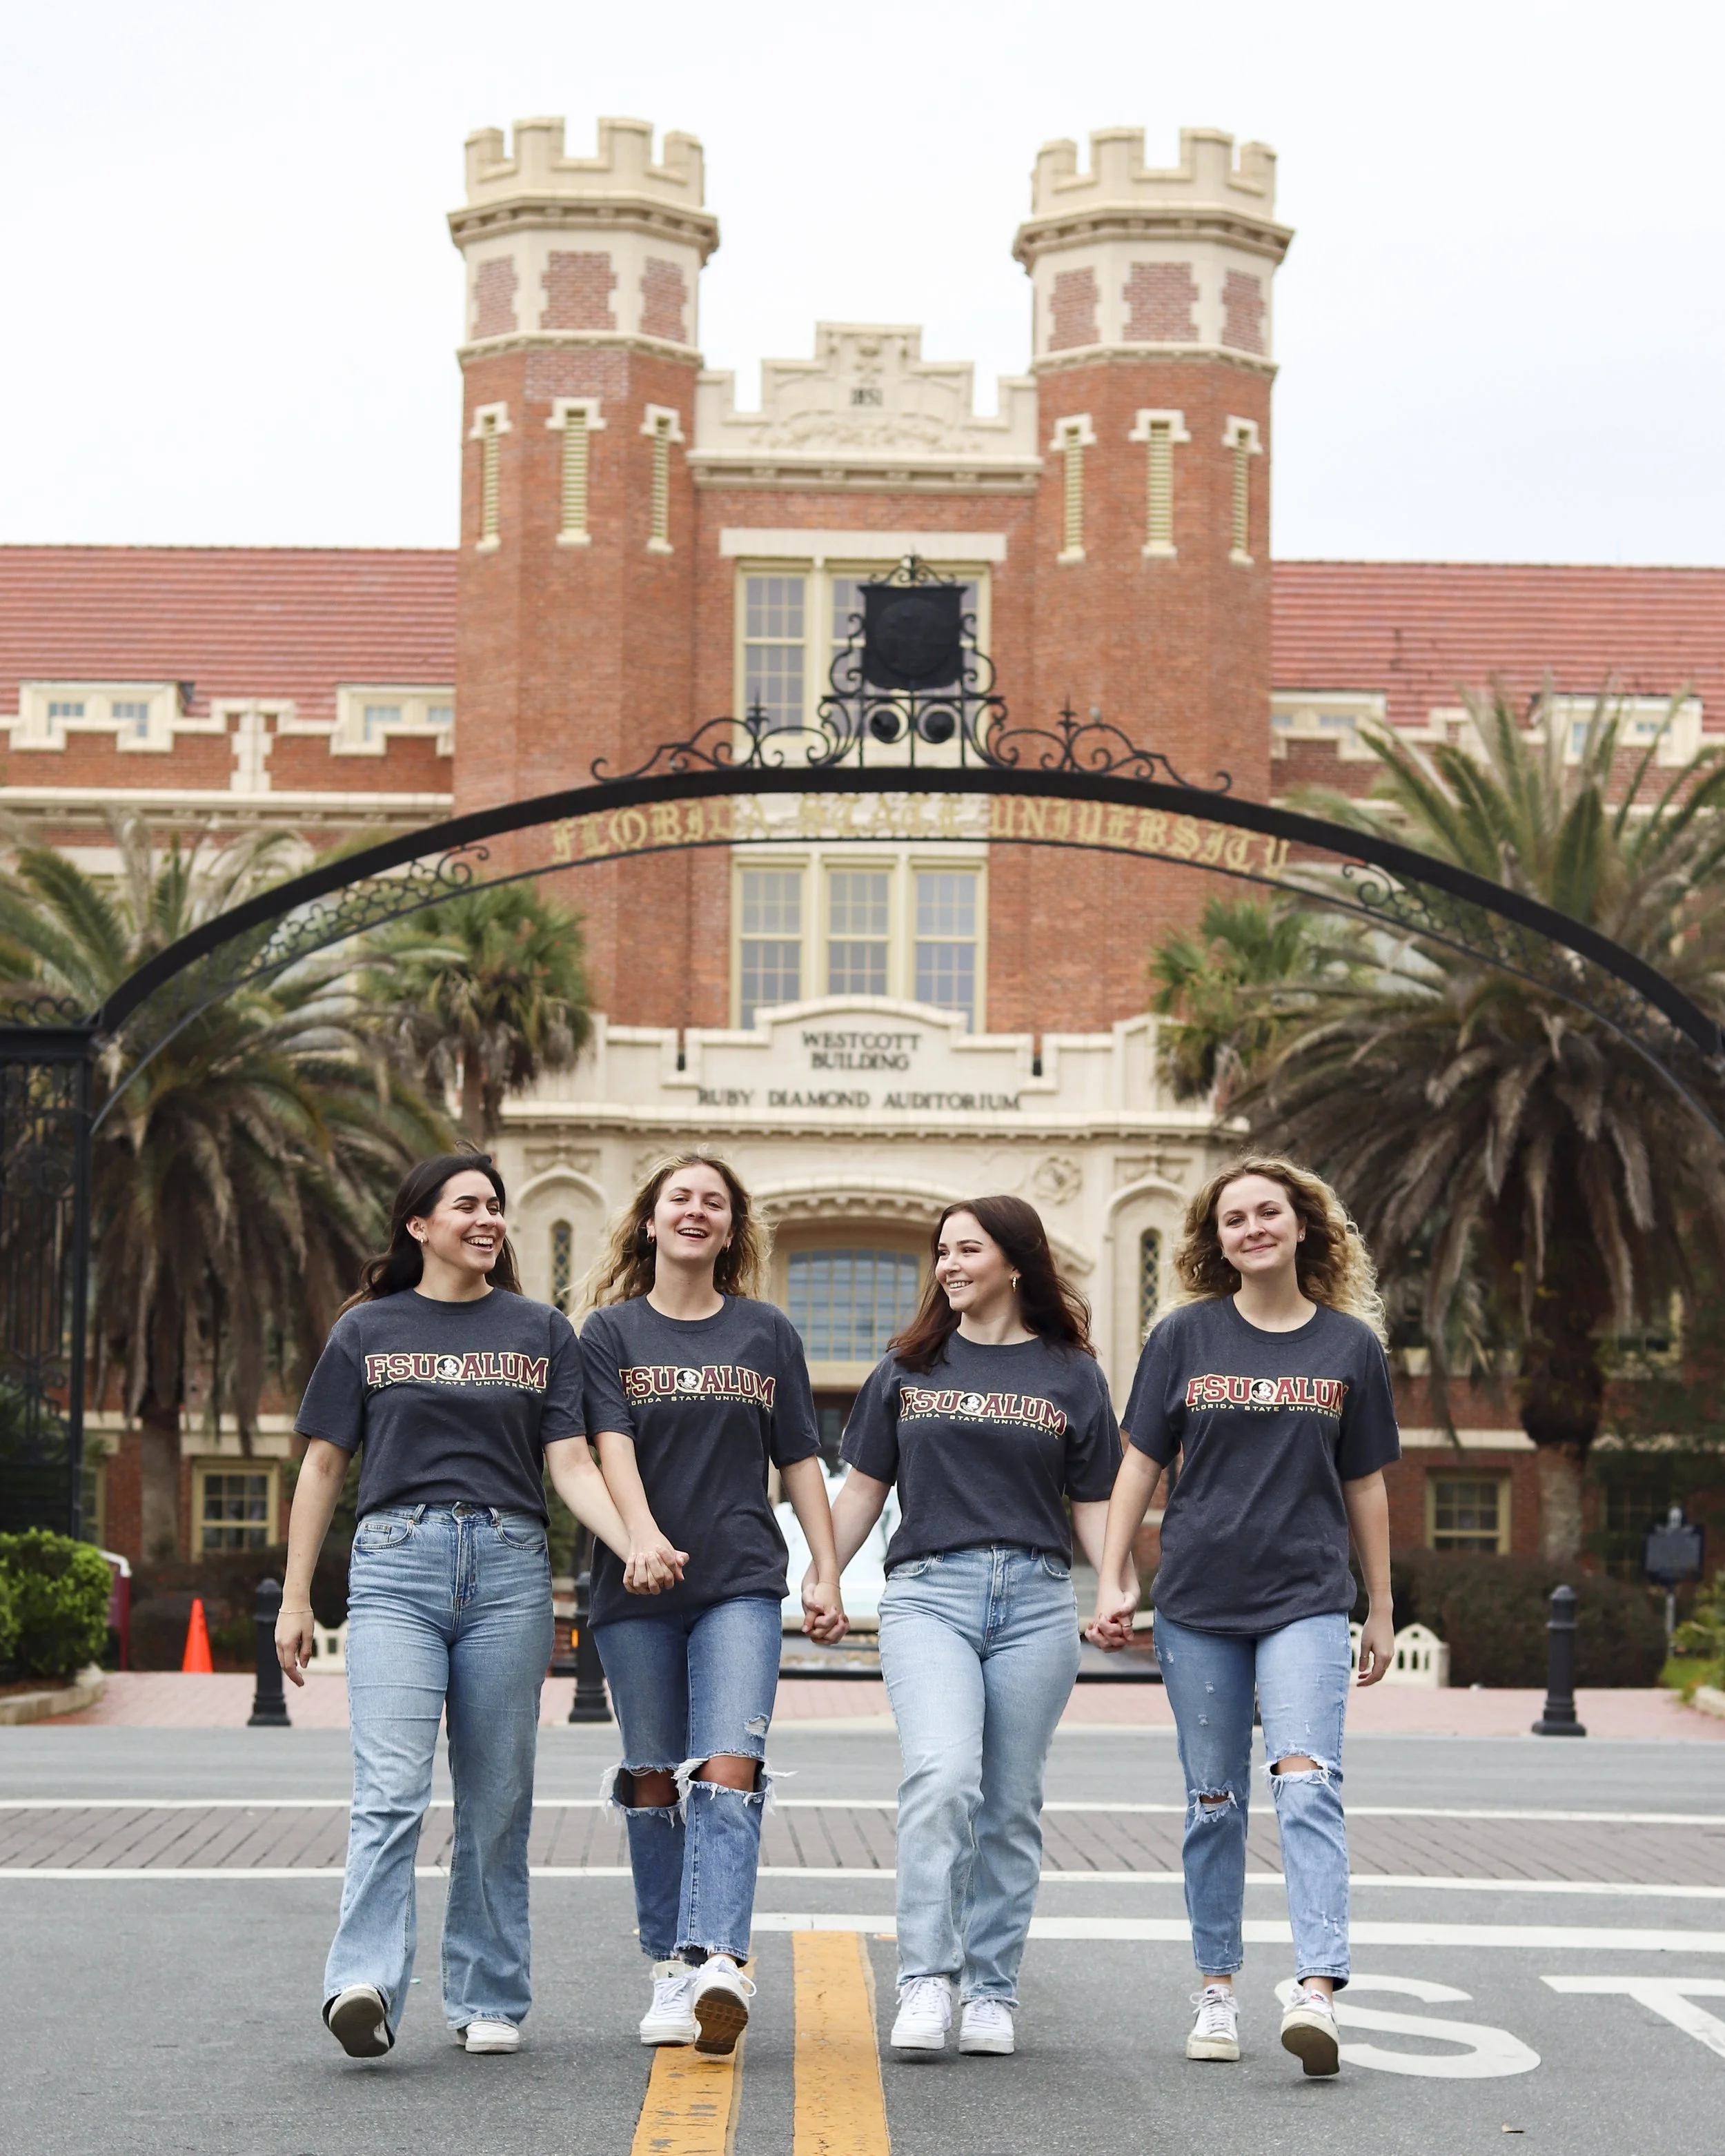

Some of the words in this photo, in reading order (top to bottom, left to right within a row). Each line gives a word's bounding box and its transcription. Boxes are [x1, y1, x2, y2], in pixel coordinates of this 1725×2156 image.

[551, 793, 771, 864] FLORIDA
[801, 1030, 921, 1050] WESTCOTT
[810, 1052, 911, 1071] BUILDING
[697, 1089, 754, 1107] RUBY
[767, 1089, 871, 1108] DIAMOND
[885, 1091, 1022, 1111] AUDITORIUM
[364, 1352, 439, 1385] FSU
[458, 1352, 549, 1389] ALUM
[475, 1381, 542, 1394] UNIVERSITY
[618, 1365, 678, 1401] FSU
[698, 1365, 776, 1408] ALUM
[1185, 1373, 1254, 1408] FSU
[631, 1396, 662, 1406] ORIDA
[899, 1386, 965, 1418] FSU
[980, 1392, 1068, 1436] ALUM
[1191, 1403, 1235, 1412] FLORIDA
[1288, 1406, 1340, 1421] UNIVERSIT
[901, 1413, 940, 1423] FLORIDA
[993, 1418, 1059, 1441] UNIVERSITY
